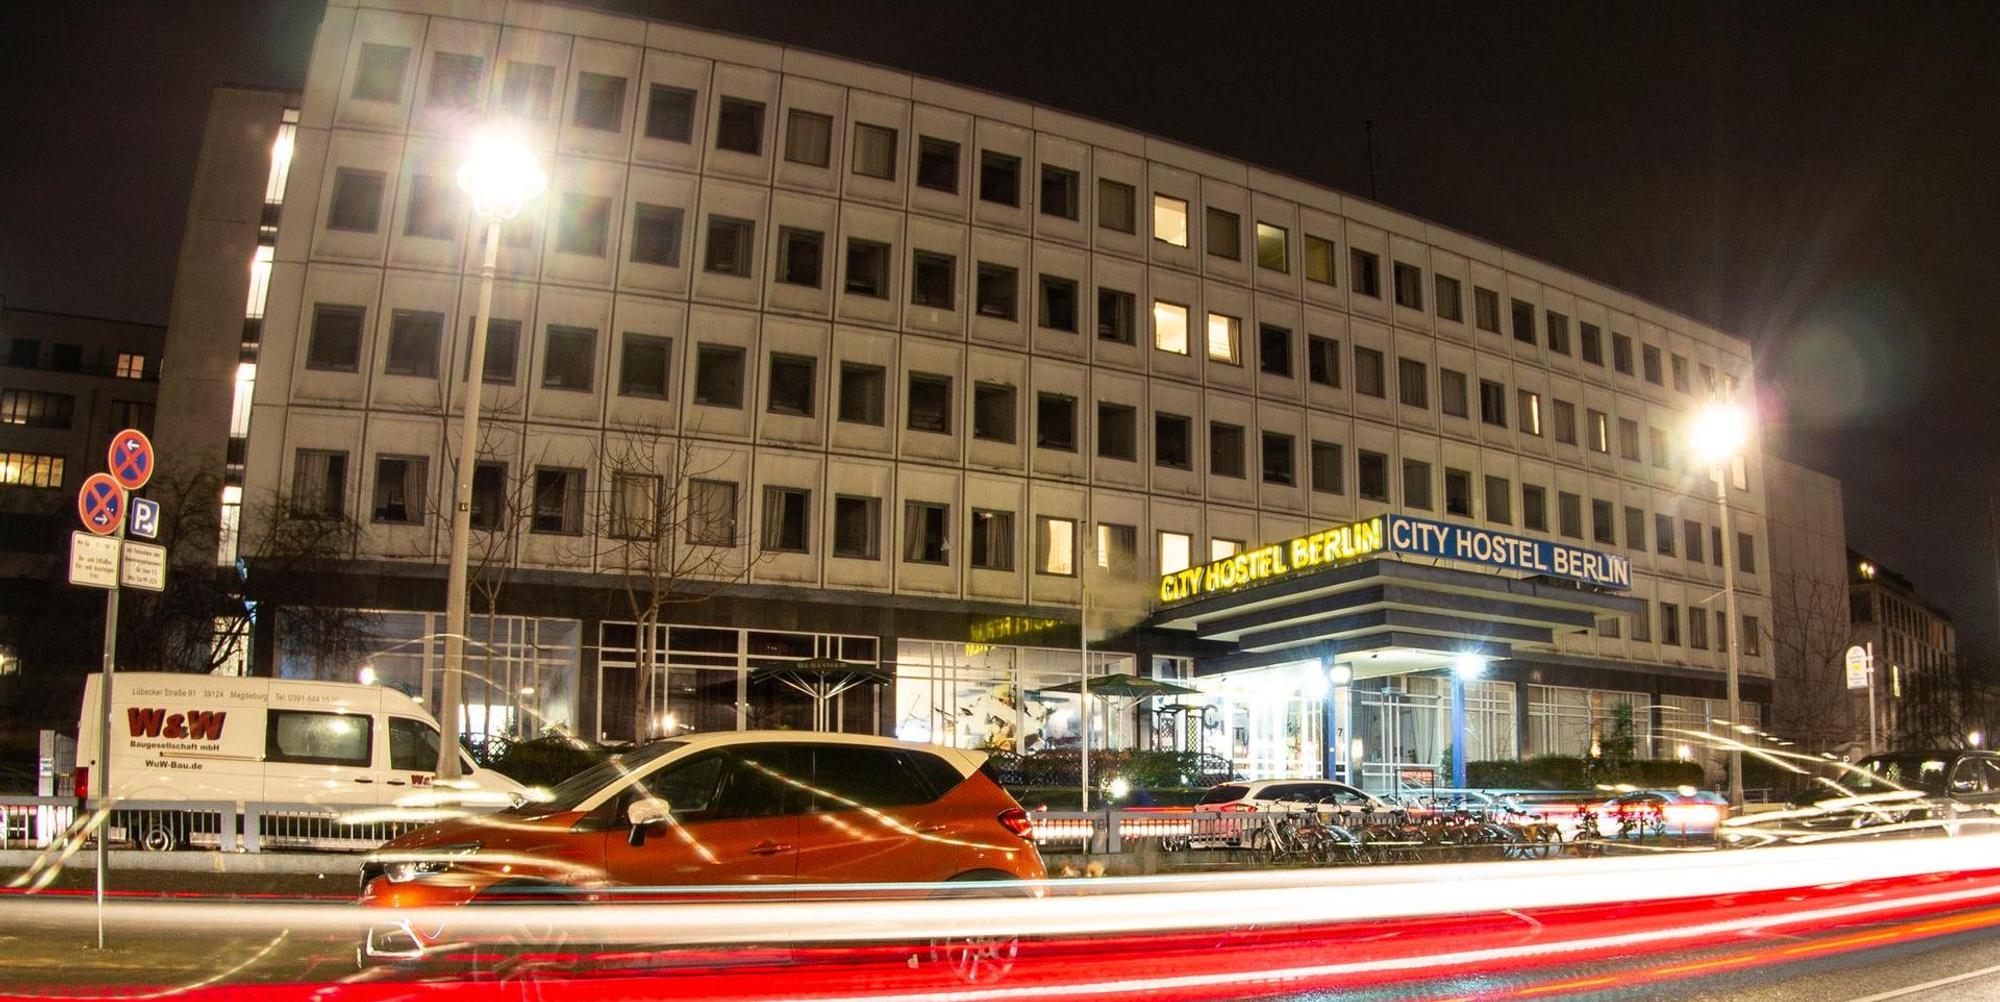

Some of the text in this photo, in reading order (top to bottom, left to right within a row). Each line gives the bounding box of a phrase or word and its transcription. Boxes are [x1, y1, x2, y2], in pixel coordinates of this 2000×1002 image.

[1161, 518, 1382, 602] CITY HOSTEL BERLIN
[1392, 519, 1628, 586] CITY HOSTEL BERLIN
[230, 690, 268, 702] Magdeburg
[127, 707, 227, 741] W&W
[130, 740, 198, 751] Baugesellschaft
[145, 760, 203, 770] WuW-Bau.de
